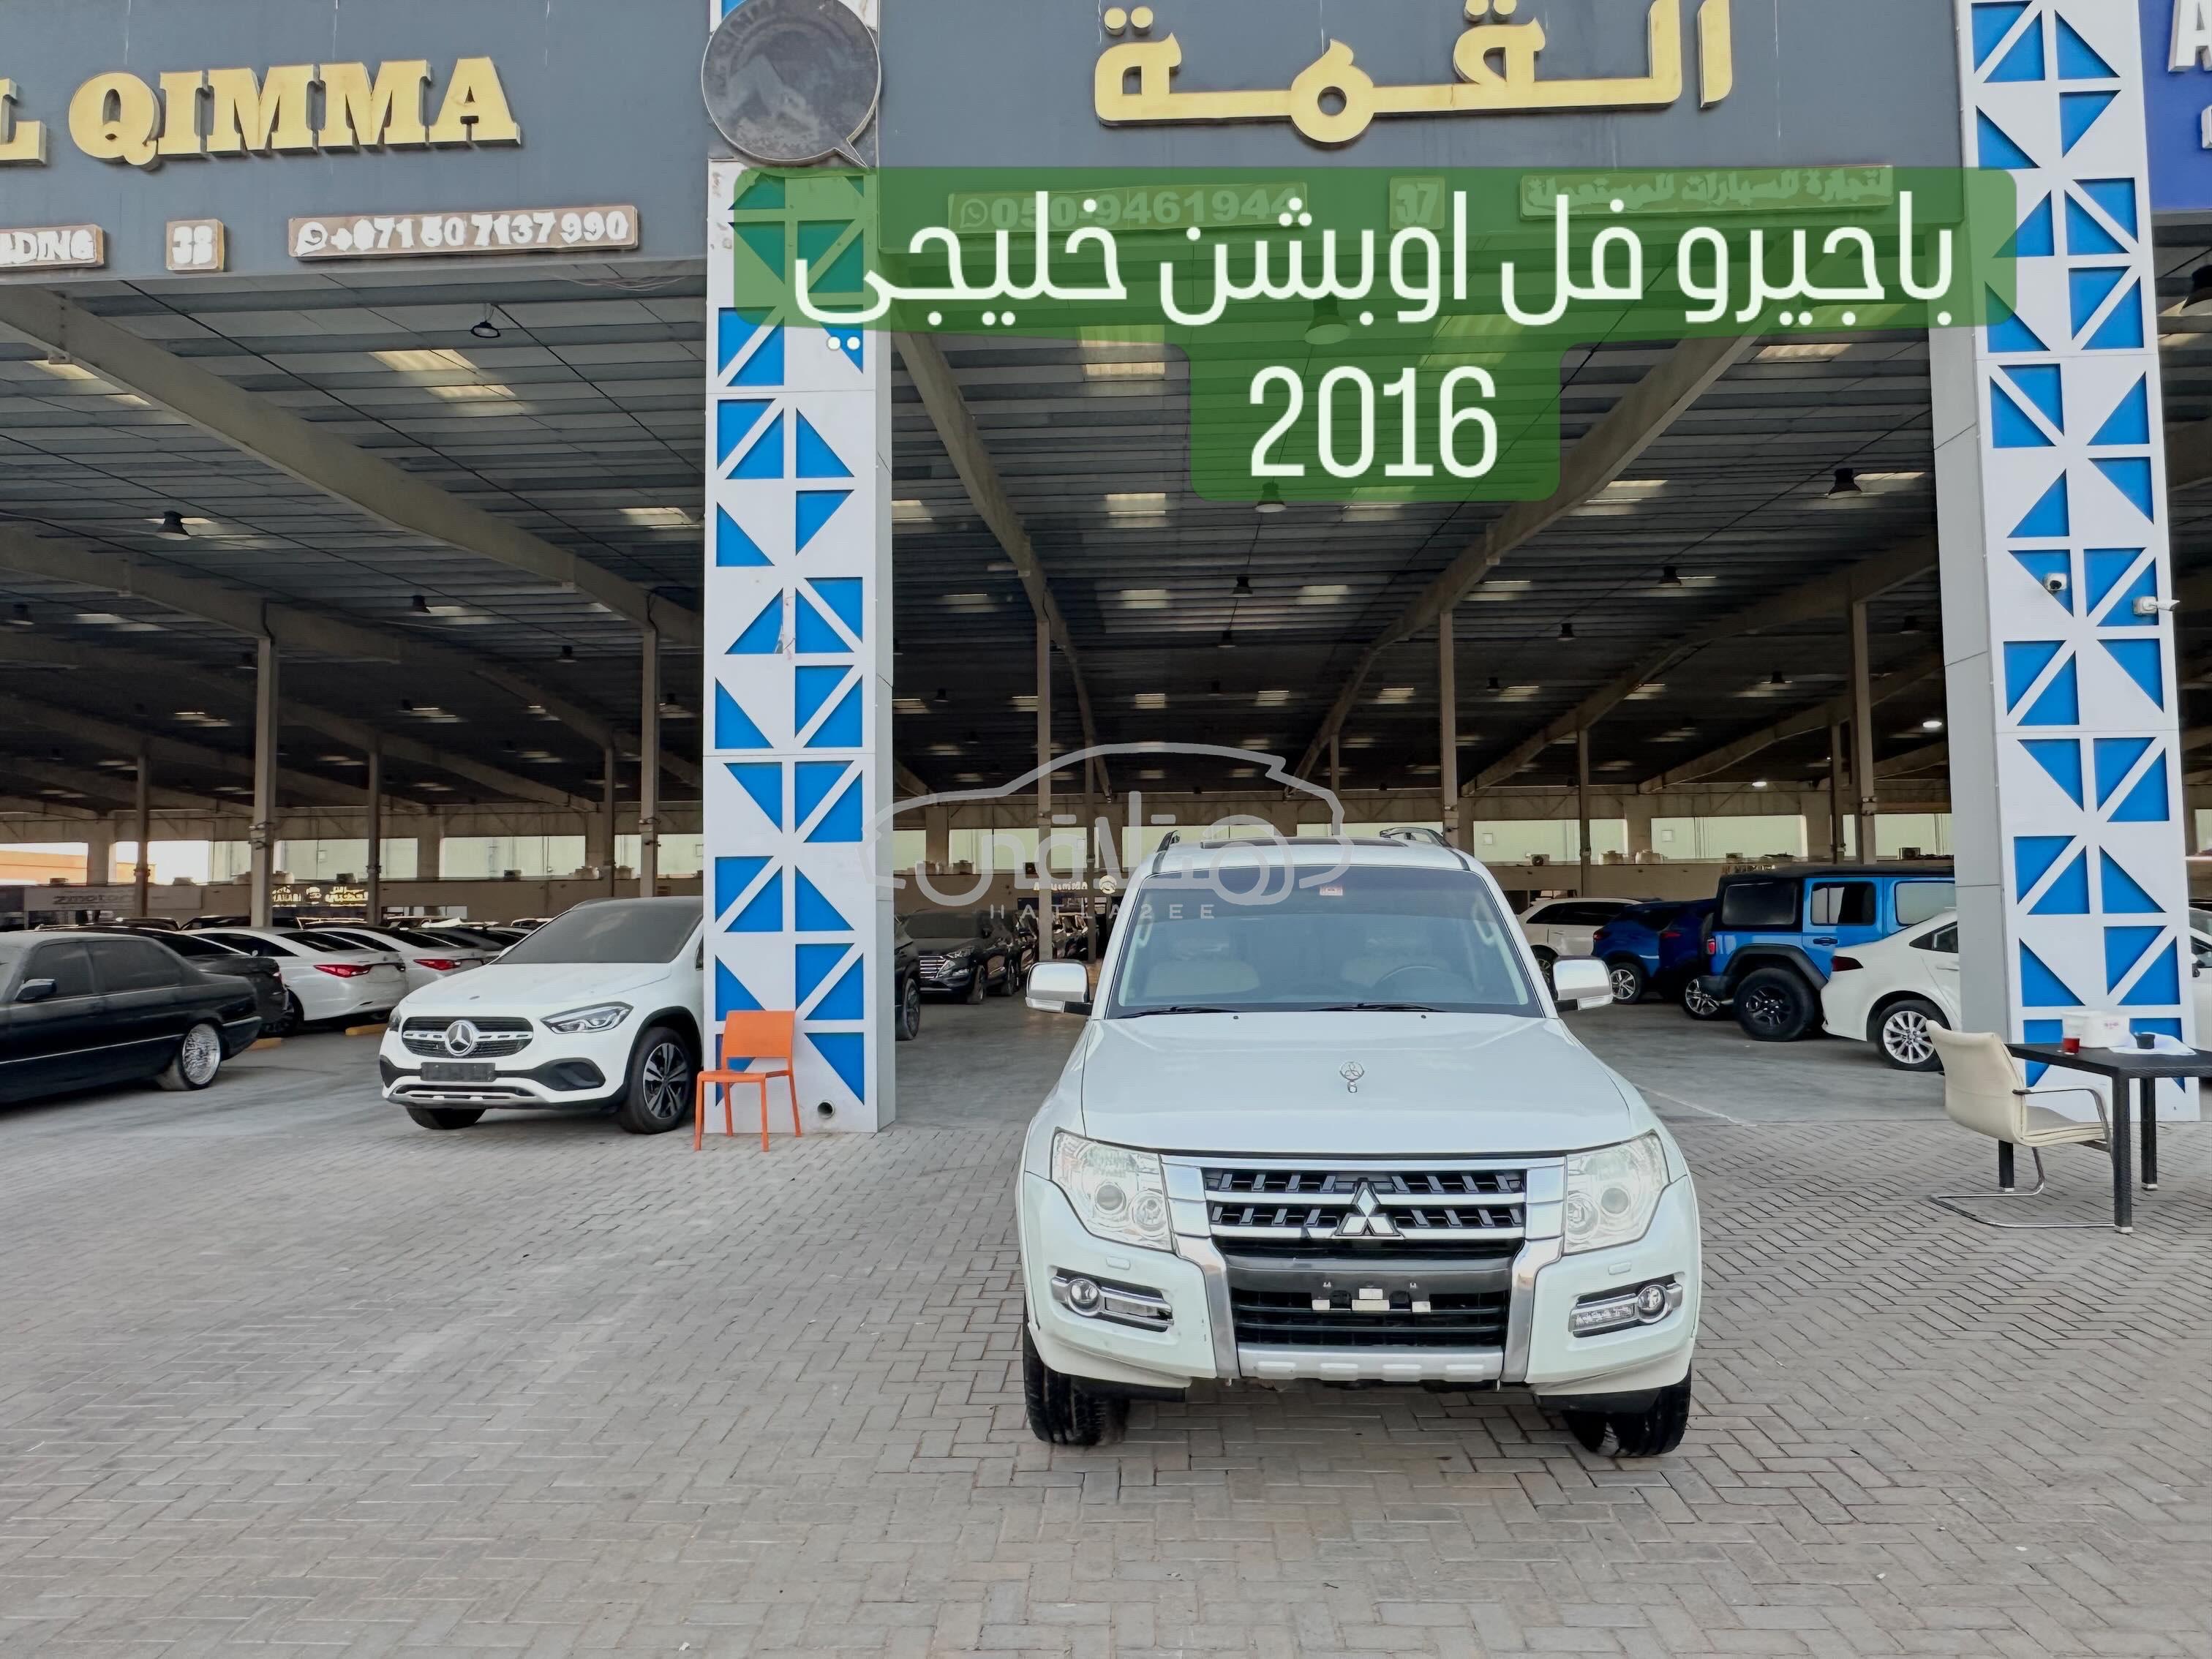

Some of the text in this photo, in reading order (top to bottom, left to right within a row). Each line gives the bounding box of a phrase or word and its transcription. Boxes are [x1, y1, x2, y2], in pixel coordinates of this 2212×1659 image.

[1096, 0, 1733, 146] القمة
[68, 56, 522, 169] QIMMA
[1396, 181, 1439, 223] 37
[172, 225, 213, 264] 38
[560, 210, 628, 244] 990
